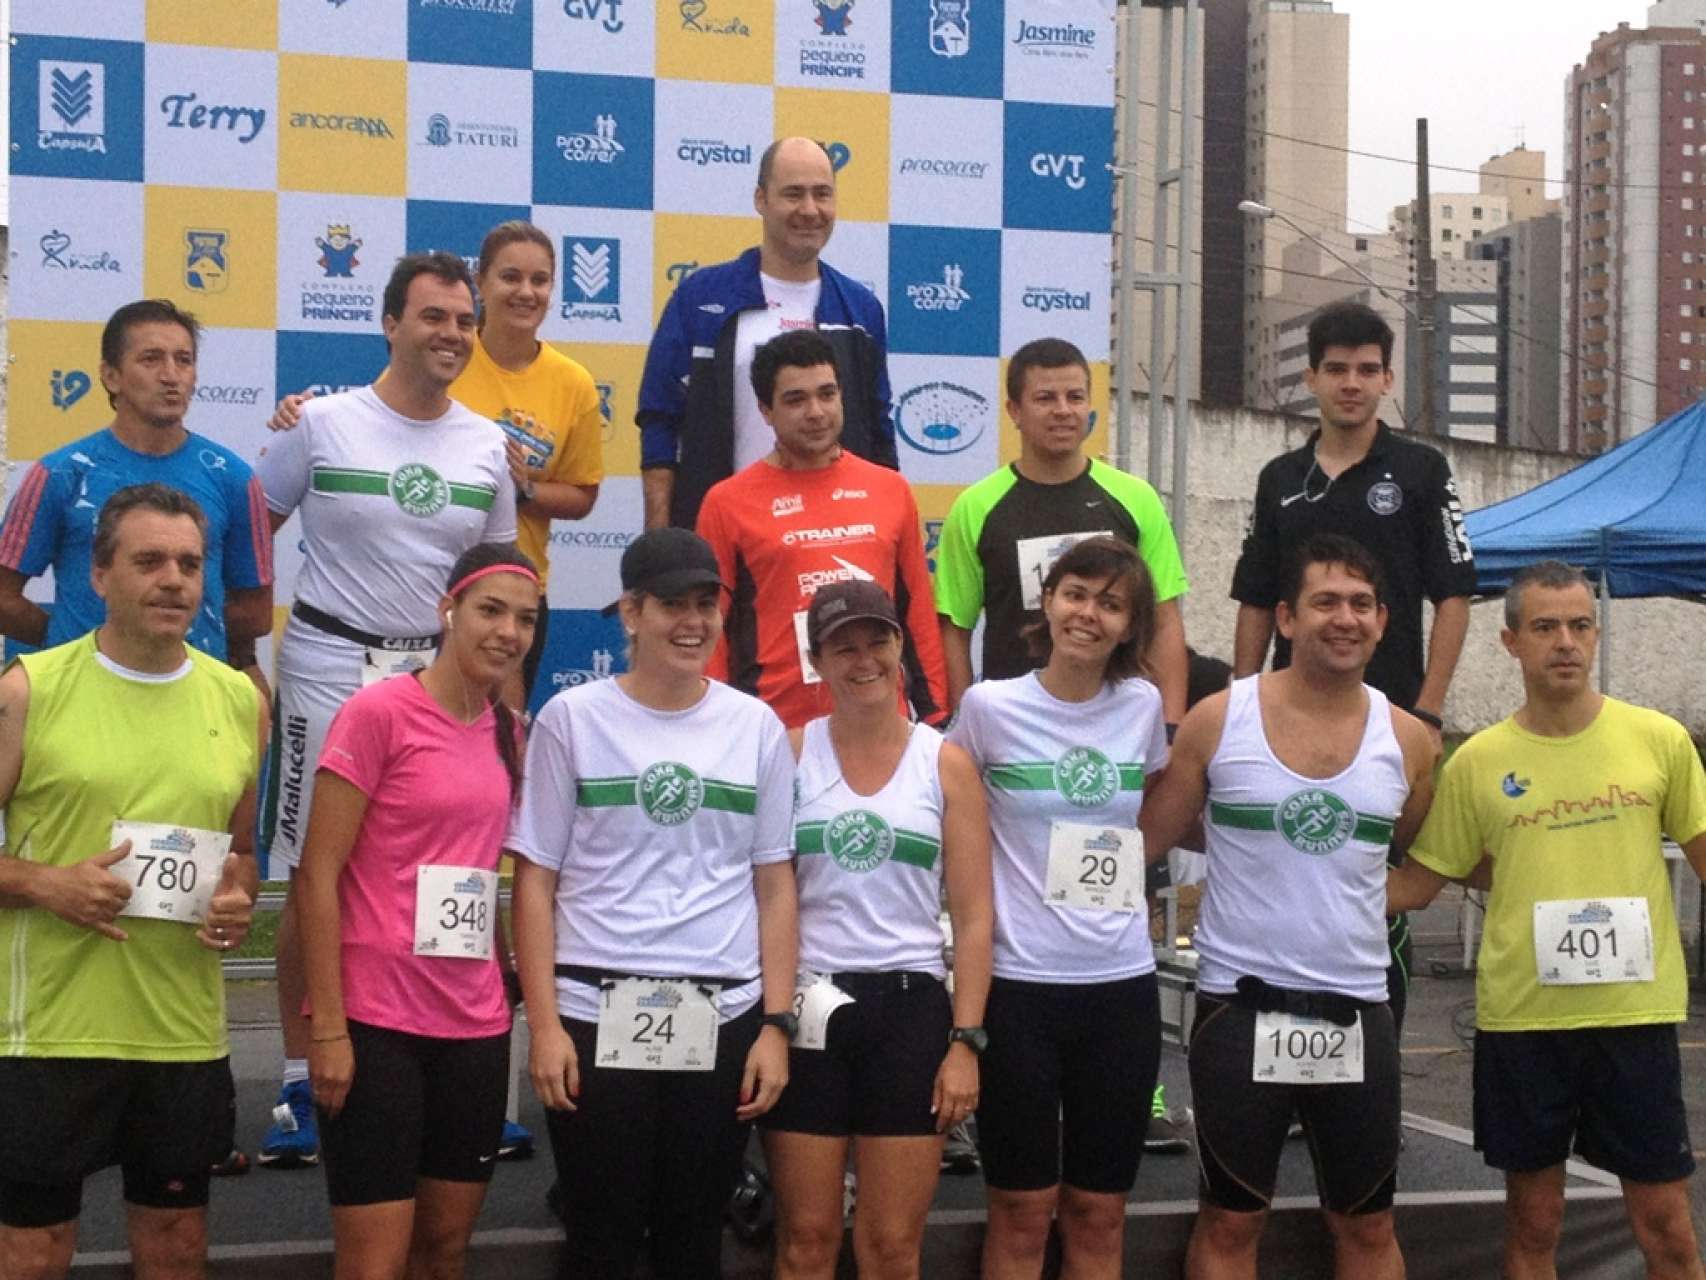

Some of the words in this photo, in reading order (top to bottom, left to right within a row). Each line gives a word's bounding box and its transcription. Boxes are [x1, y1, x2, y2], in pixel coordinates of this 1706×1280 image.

[1012, 20, 1096, 44] Jasmine
[800, 50, 866, 66] pequeno
[161, 92, 267, 143] Terry
[556, 136, 585, 150] pro
[678, 144, 751, 166] crystal
[900, 157, 989, 174] procorrer
[1031, 153, 1086, 185] GVT
[302, 292, 375, 308] pequeno
[907, 284, 932, 297] pro
[1022, 291, 1090, 312] crystal
[197, 386, 264, 401] correr
[792, 524, 877, 544] TRAINER
[383, 638, 432, 650] CAIXA
[135, 854, 197, 893] 780
[1078, 854, 1118, 886] 29
[439, 897, 488, 933] 348
[1556, 927, 1618, 960] 401
[631, 1012, 676, 1045] 24
[1268, 1028, 1347, 1060] 1002
